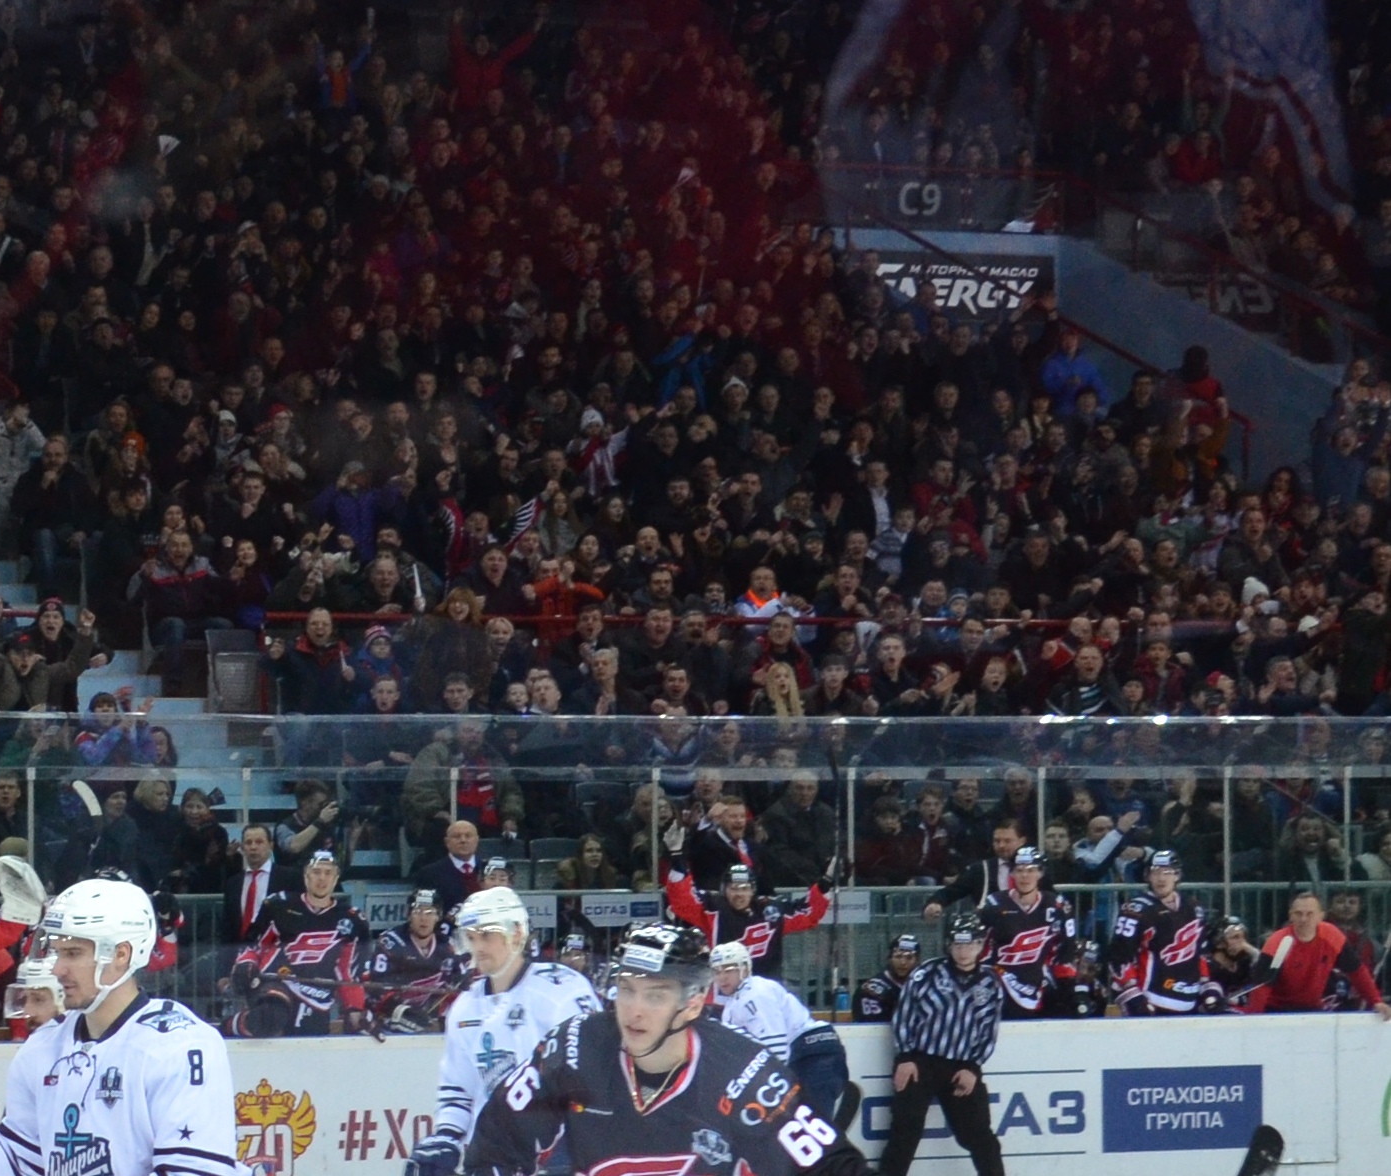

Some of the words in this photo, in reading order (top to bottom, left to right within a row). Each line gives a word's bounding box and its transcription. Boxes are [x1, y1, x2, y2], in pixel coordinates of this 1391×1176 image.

[187, 1049, 204, 1086] 8
[1126, 1084, 1244, 1107] СТРАХОВАЯ
[1145, 1110, 1225, 1131] ГРУППА
[777, 1105, 838, 1168] 66
